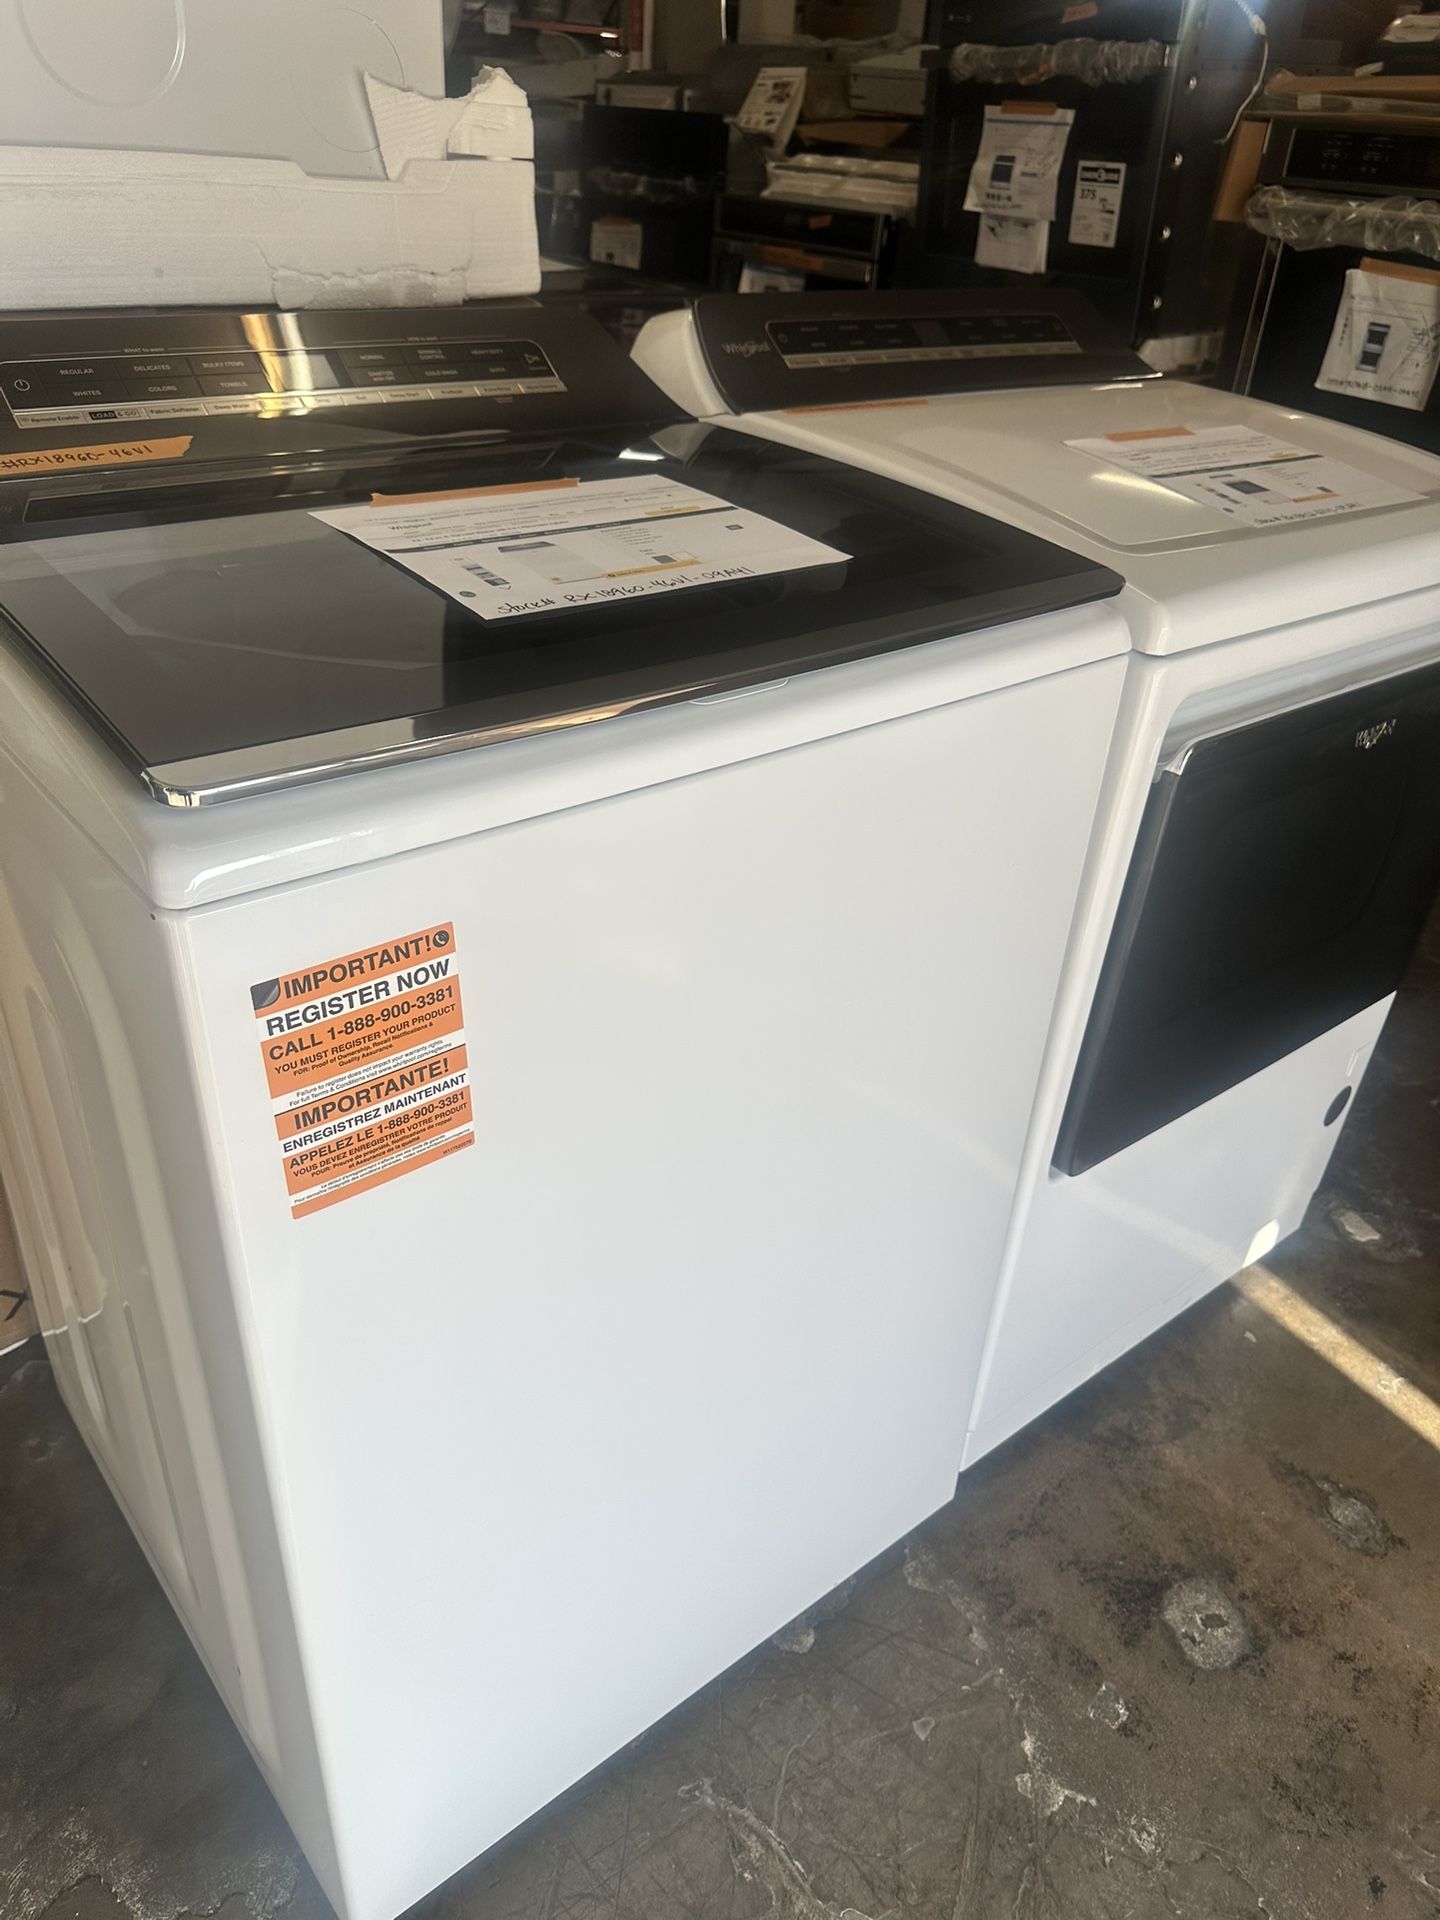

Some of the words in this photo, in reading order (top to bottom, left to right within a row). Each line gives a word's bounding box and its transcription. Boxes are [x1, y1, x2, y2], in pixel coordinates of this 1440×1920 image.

[60, 368, 94, 376] REGULAR
[134, 364, 171, 372] DELICATES
[91, 411, 115, 420] LOAD
[283, 934, 431, 999] IMPORTANT!
[265, 978, 390, 1037] REGISTER
[396, 958, 450, 992] NOW
[268, 1030, 322, 1061] CALL
[326, 984, 452, 1041] 1-888-900-3381
[274, 1060, 297, 1075] YOU
[299, 1049, 328, 1066] MUST
[330, 1030, 380, 1055] REGISTER
[382, 1020, 409, 1036] YOUR
[411, 1003, 455, 1026] PRODUCT
[293, 1066, 310, 1076] FOR:
[311, 1059, 328, 1070] Proof
[337, 1043, 371, 1061] Ownership,
[372, 1036, 390, 1047] Recall
[392, 1023, 427, 1040] Notifications
[338, 1054, 360, 1067] Quality
[289, 1098, 300, 1107] For
[311, 1088, 329, 1099] Terms
[294, 1056, 449, 1130] IMPORTANTE!
[296, 1085, 317, 1098] Failure
[325, 1074, 347, 1088] register
[347, 1069, 361, 1079] does
[372, 1058, 391, 1070] impact
[283, 1106, 381, 1154] ENREGISTREZ
[383, 1072, 466, 1114] MAINTENANT
[289, 1135, 353, 1169] APPELEZ
[356, 1127, 373, 1142] LE
[377, 1090, 464, 1134] 1-888-900-3381
[293, 1162, 318, 1178] VOUS
[319, 1150, 347, 1167] DEVEZ
[348, 1127, 405, 1155] ENREGISTRER
[406, 1115, 432, 1132] VOTRE
[434, 1101, 467, 1120] PRODUIT
[333, 1157, 353, 1169] Preuve
